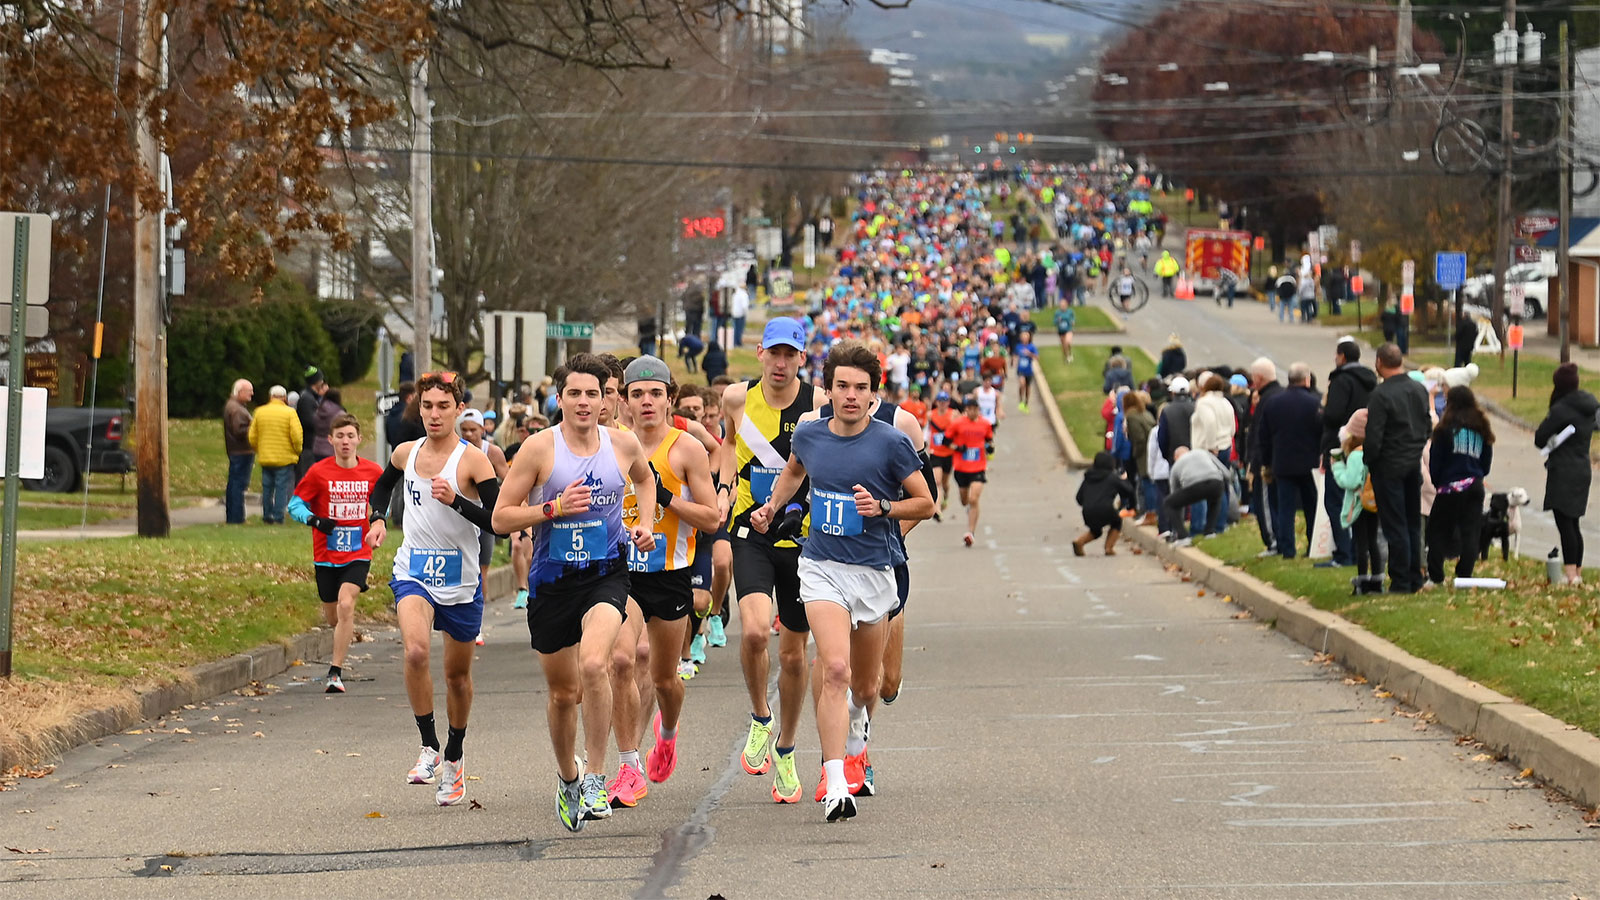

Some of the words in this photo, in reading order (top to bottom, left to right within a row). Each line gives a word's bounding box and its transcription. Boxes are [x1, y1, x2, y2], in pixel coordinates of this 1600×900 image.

[328, 480, 369, 493] LEHIGH
[823, 500, 844, 525] 11
[336, 531, 352, 545] 21
[571, 529, 584, 551] 5
[423, 556, 447, 577] 42
